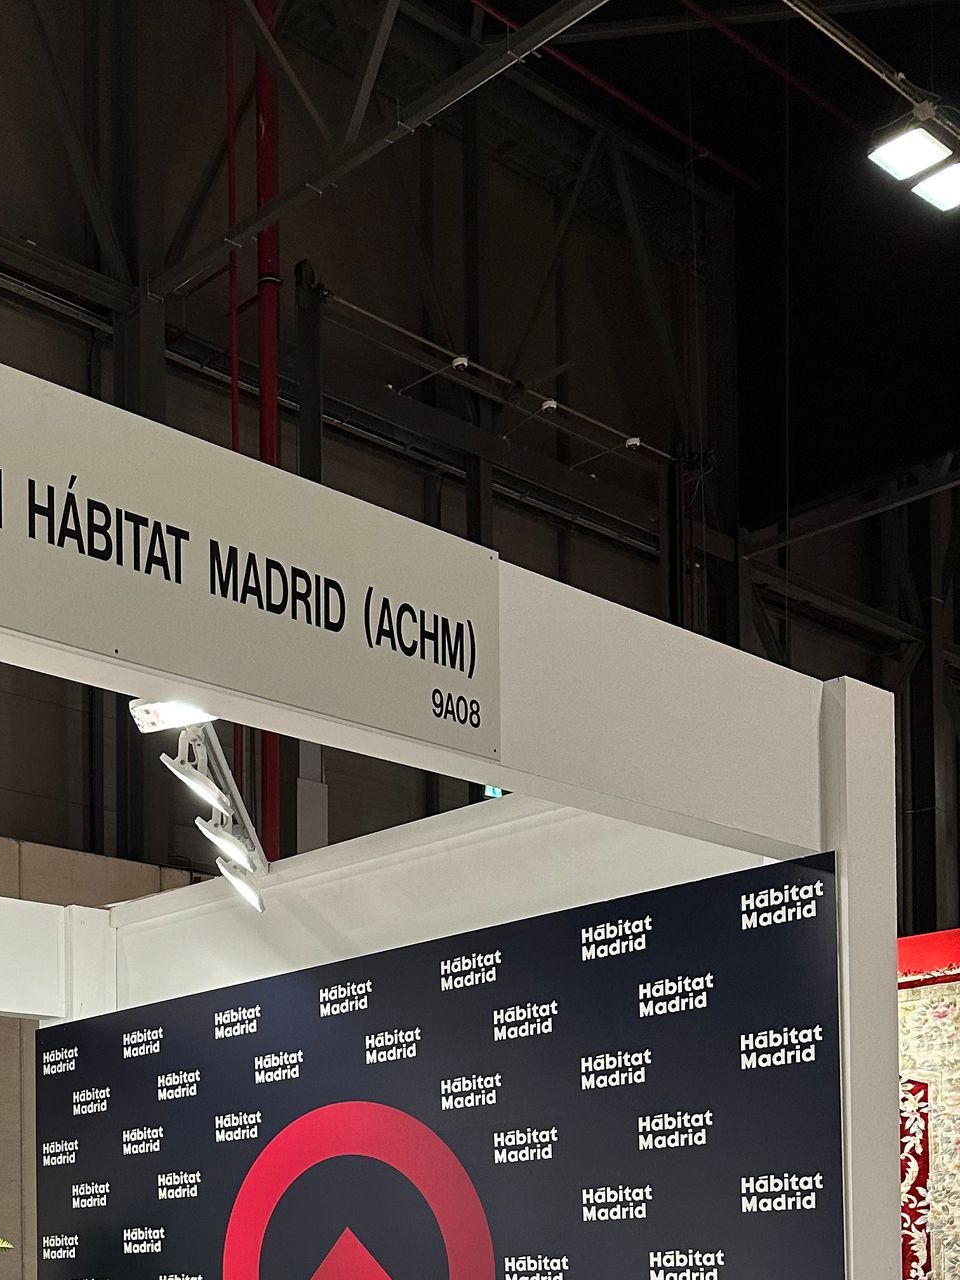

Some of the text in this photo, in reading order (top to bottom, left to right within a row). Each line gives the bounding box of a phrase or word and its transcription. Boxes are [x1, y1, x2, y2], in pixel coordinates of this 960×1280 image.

[27, 474, 190, 585] HÁBITAT
[209, 538, 346, 633] MADRID
[364, 585, 476, 680] (ACHM)
[431, 688, 481, 729] 9A08
[742, 900, 816, 930] Madrid
[582, 934, 646, 961] Madrid
[441, 967, 496, 991] Madrid
[320, 995, 367, 1017] Madrid
[639, 992, 706, 1017] Madrid
[215, 1020, 257, 1039] Madrid
[494, 1018, 552, 1041] Madrid
[124, 1041, 159, 1058] Madrid
[366, 1043, 416, 1064] Madrid
[741, 1044, 815, 1069] Madrid
[44, 1059, 75, 1075] Madrid
[255, 1065, 299, 1083] Madrid
[582, 1067, 645, 1090] Madrid
[158, 1083, 196, 1100] Madrid
[442, 1090, 496, 1110] Madrid
[73, 1100, 107, 1115] Madrid
[216, 1125, 257, 1142] Madrid
[639, 1129, 706, 1150] Madrid
[123, 1140, 160, 1155] Madrid
[494, 1144, 552, 1163] Madrid
[43, 1152, 75, 1166] Madrid
[73, 1195, 106, 1208] Madrid
[158, 1185, 197, 1199] Madrid
[583, 1202, 646, 1221] Madrid
[742, 1192, 815, 1212] Madrid
[43, 1247, 75, 1259] Madrid
[124, 1240, 161, 1253] Madrid
